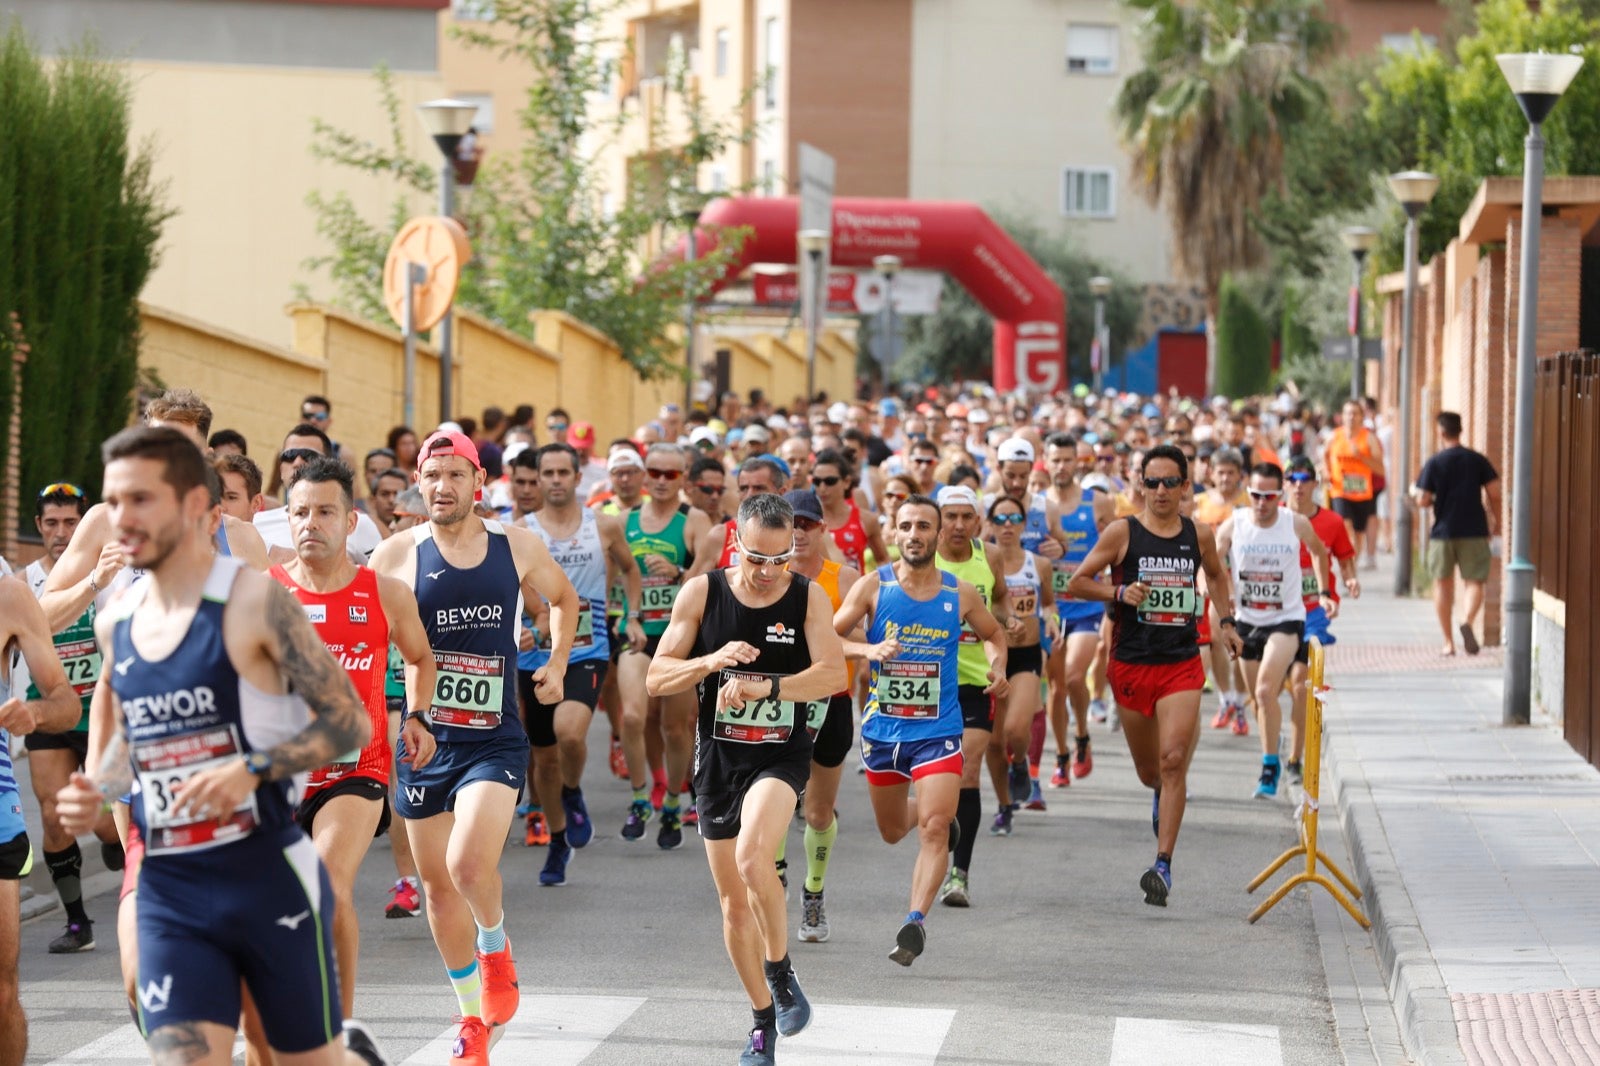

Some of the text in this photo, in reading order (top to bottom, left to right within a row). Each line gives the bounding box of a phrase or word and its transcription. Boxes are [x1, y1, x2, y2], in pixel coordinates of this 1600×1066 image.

[1240, 544, 1292, 554] ANGUITA
[554, 552, 592, 564] RACENA
[1138, 556, 1194, 571] GRANADA
[1245, 583, 1280, 597] 3062
[1149, 589, 1185, 608] 981
[437, 605, 502, 625] BEWOR
[437, 623, 468, 633] SOFTWARE
[902, 623, 949, 640] olimpo
[444, 655, 459, 664] GRAN
[460, 656, 478, 667] PREMIO
[437, 675, 491, 706] 660
[888, 680, 930, 701] 534
